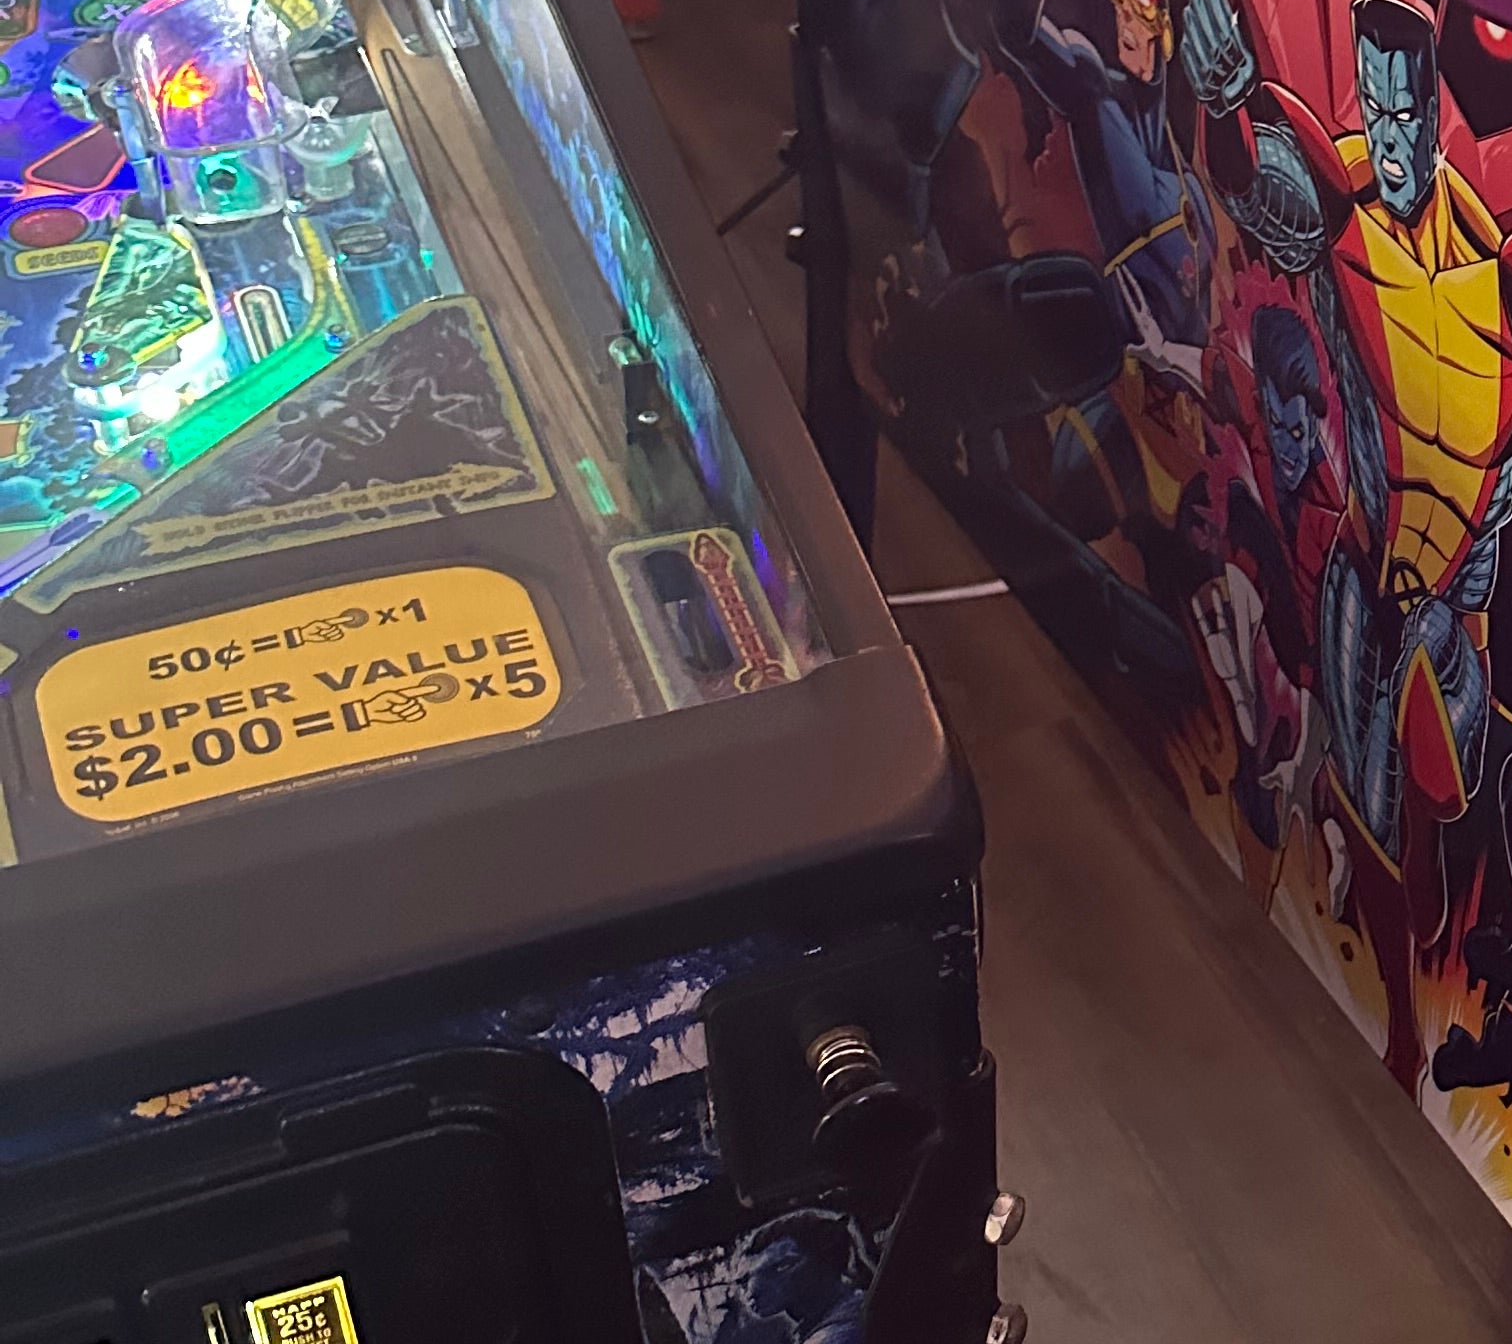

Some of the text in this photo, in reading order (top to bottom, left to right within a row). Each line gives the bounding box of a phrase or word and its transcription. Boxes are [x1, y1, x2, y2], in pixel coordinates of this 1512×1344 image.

[64, 628, 536, 753] SUPER VALUE
[278, 1313, 328, 1340] 25¢
[316, 1327, 333, 1339] TO
